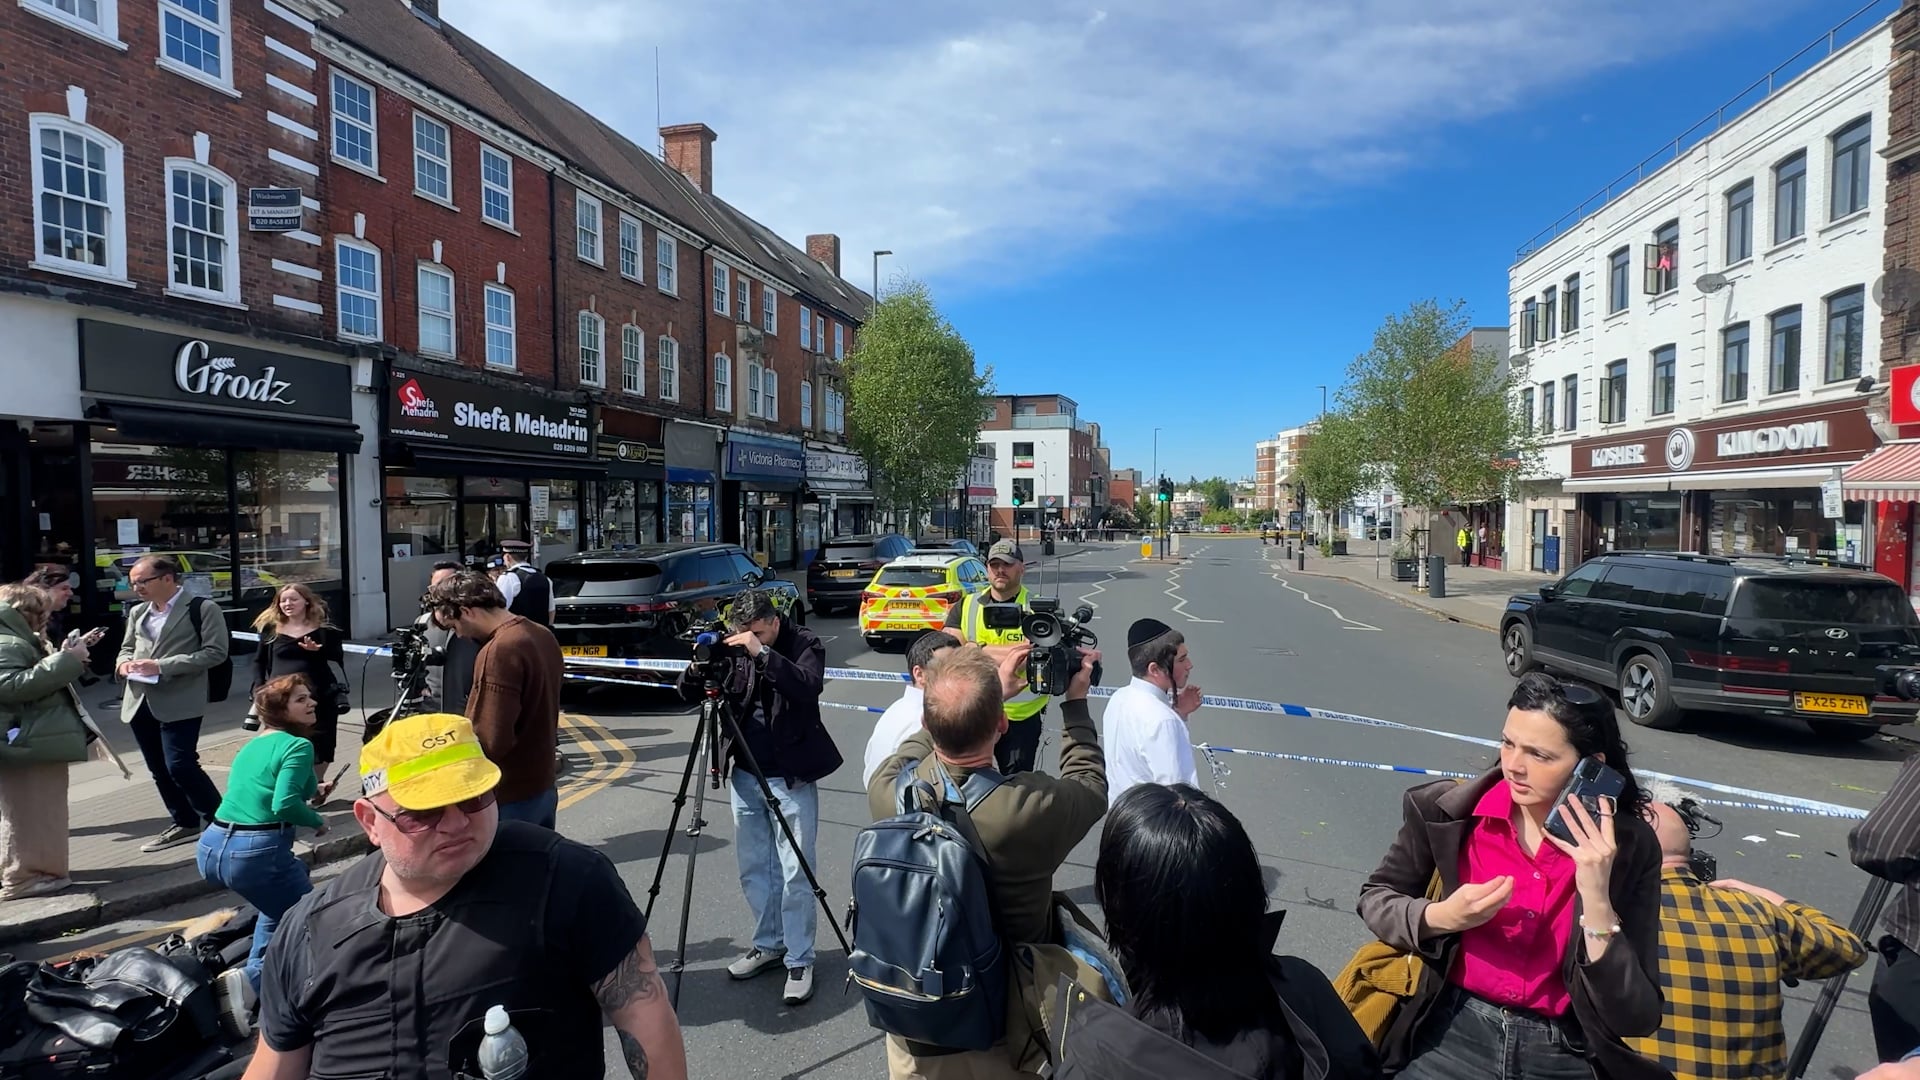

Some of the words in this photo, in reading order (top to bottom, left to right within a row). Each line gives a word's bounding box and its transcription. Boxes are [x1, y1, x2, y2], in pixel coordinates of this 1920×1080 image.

[175, 340, 296, 405] Grodz
[406, 386, 435, 408] Shefa
[401, 405, 439, 418] Mehadrin
[453, 402, 511, 432] Shefa
[515, 412, 588, 442] Mehadrin
[1591, 444, 1647, 467] KOSHER
[1717, 420, 1829, 457] KINGDOM
[748, 451, 773, 466] Victoria
[774, 453, 803, 472] Pharmacy
[1007, 633, 1024, 641] CST
[571, 646, 581, 656] G7
[583, 646, 600, 656] NGR
[1768, 646, 1857, 657] SANTA
[1090, 687, 1104, 696] NOT
[1215, 697, 1227, 706] DO
[1227, 698, 1245, 708] NOT
[1246, 700, 1274, 712] CROSS
[1803, 696, 1838, 709] FX25
[1839, 698, 1865, 711] ZFH
[422, 730, 457, 749] CST
